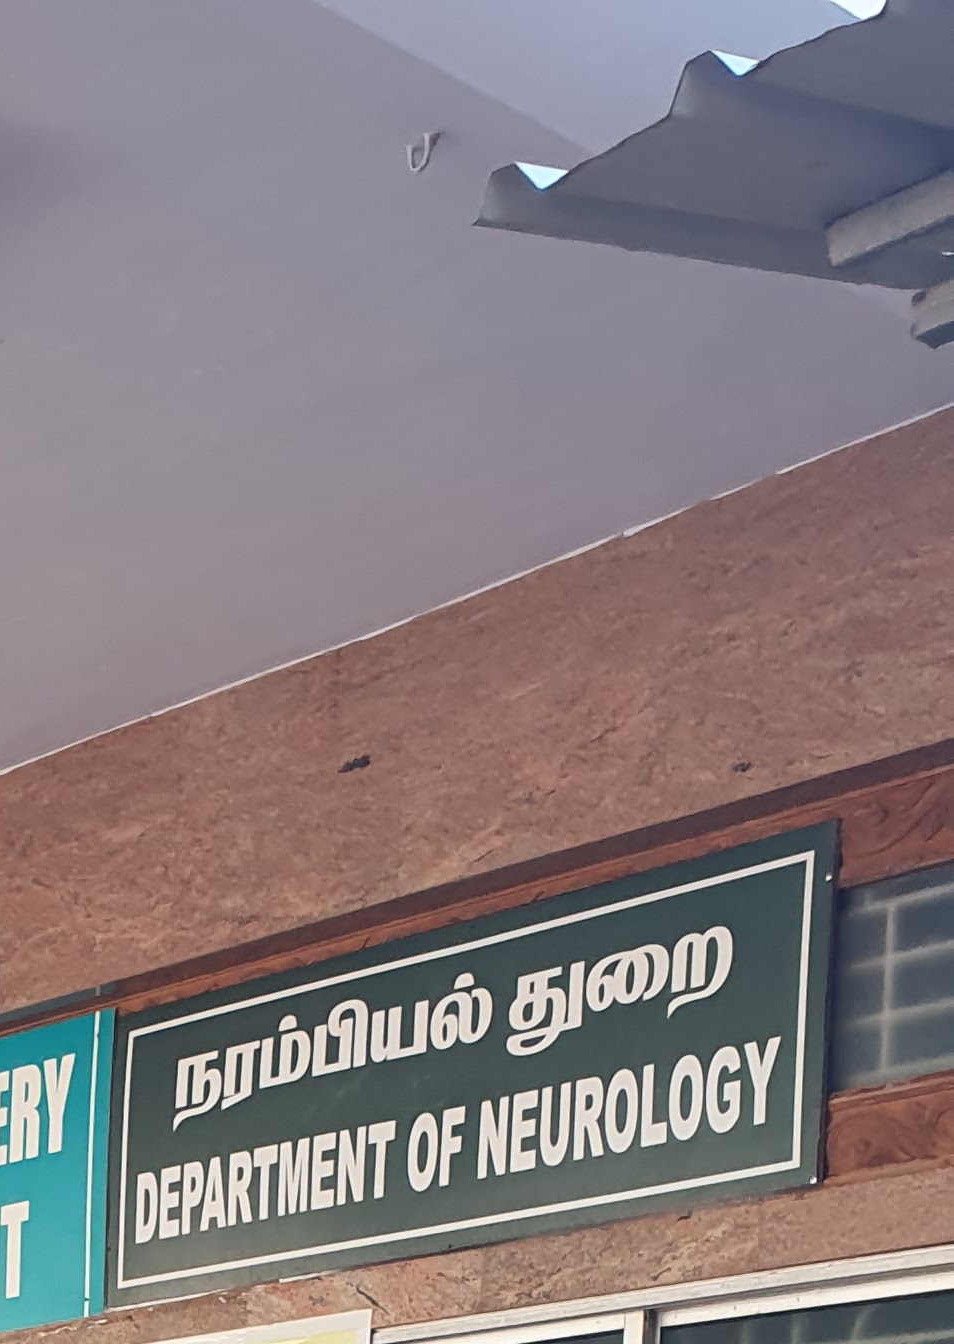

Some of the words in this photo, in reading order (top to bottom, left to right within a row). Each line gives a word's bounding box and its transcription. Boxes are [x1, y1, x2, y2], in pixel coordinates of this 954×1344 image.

[172, 971, 494, 1132] நரம்பியல்
[505, 925, 735, 1058] துறை
[134, 1120, 397, 1245] DEPARTMENT
[406, 1105, 466, 1193] OF
[475, 1035, 783, 1181] NEUROLOGY
